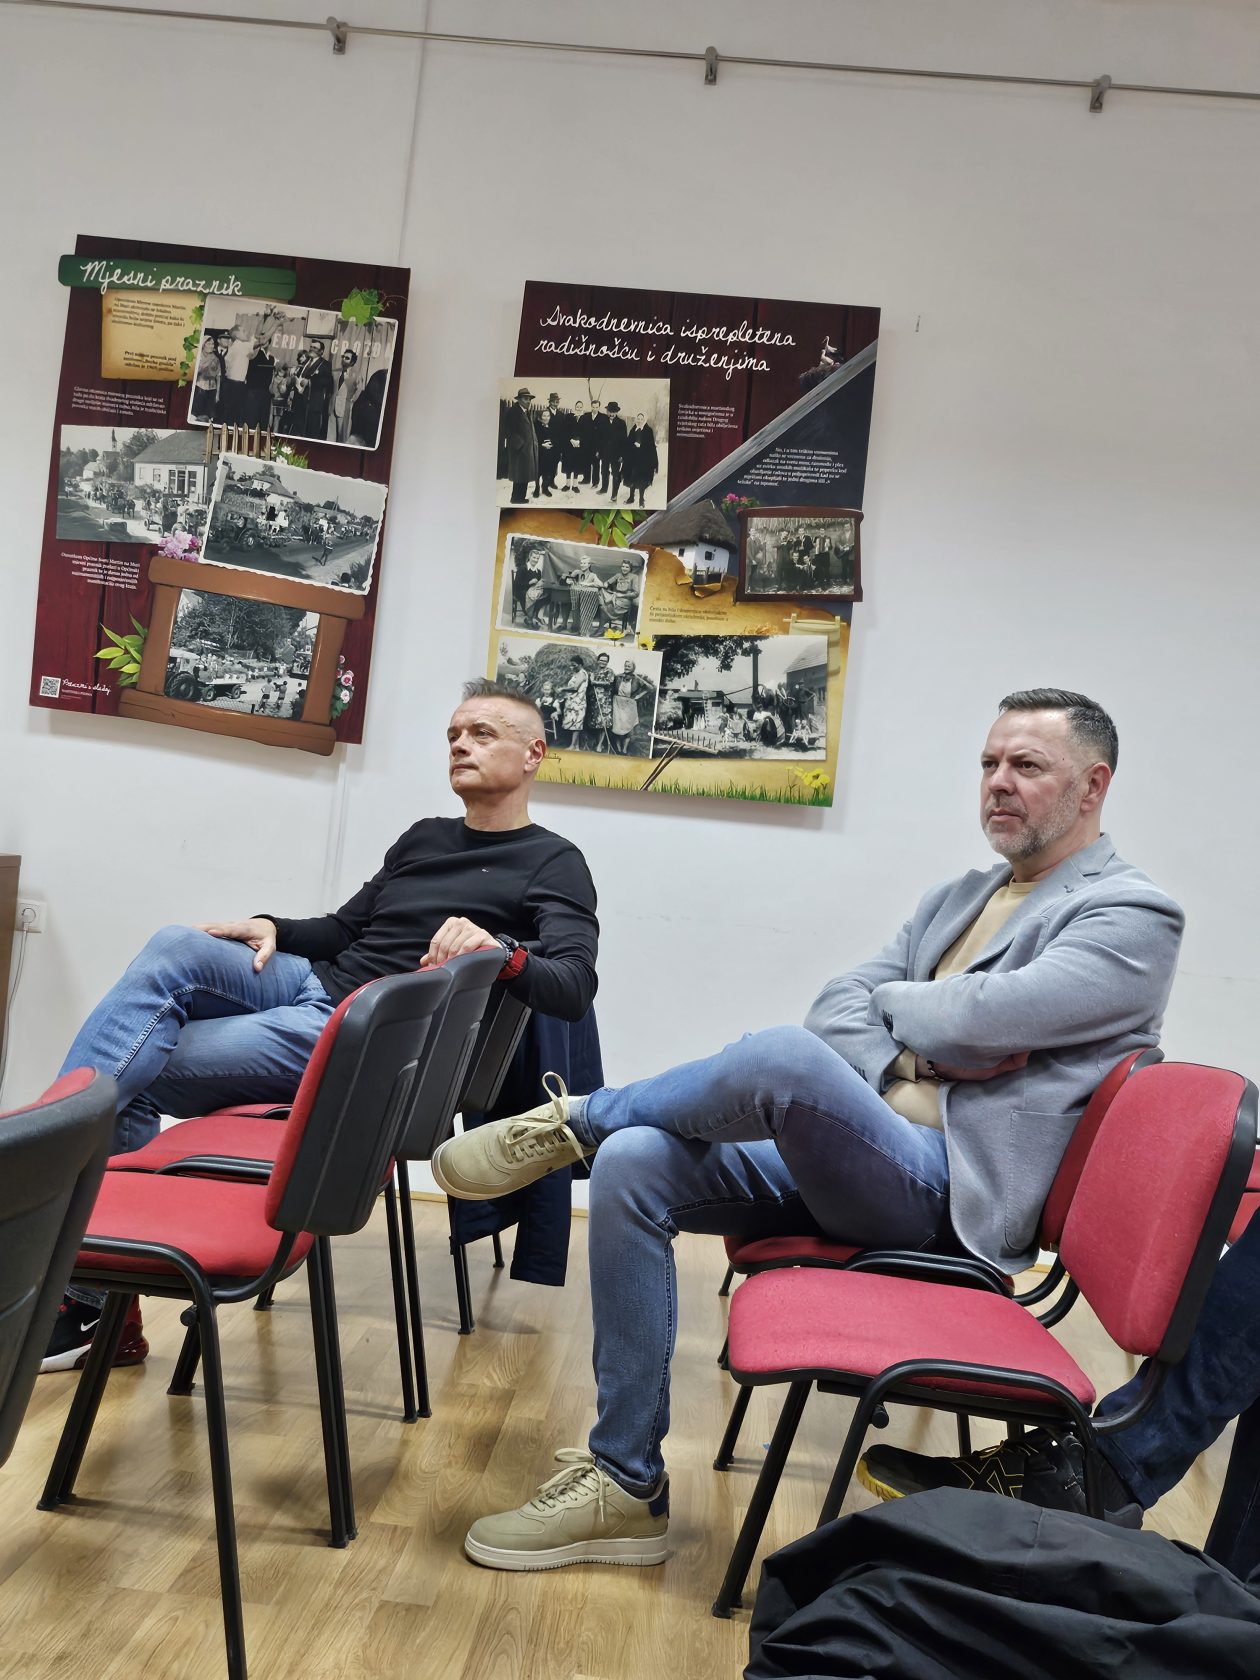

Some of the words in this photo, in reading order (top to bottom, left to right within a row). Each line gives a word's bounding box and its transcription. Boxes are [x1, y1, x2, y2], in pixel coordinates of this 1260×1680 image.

[80, 261, 156, 294] Mjesni
[160, 275, 242, 295] praznik
[540, 305, 674, 335] Svakodnevnica
[681, 319, 796, 346] isprepletena
[535, 335, 640, 361] radišnošću
[646, 343, 656, 362] i
[661, 344, 771, 380] druženjima
